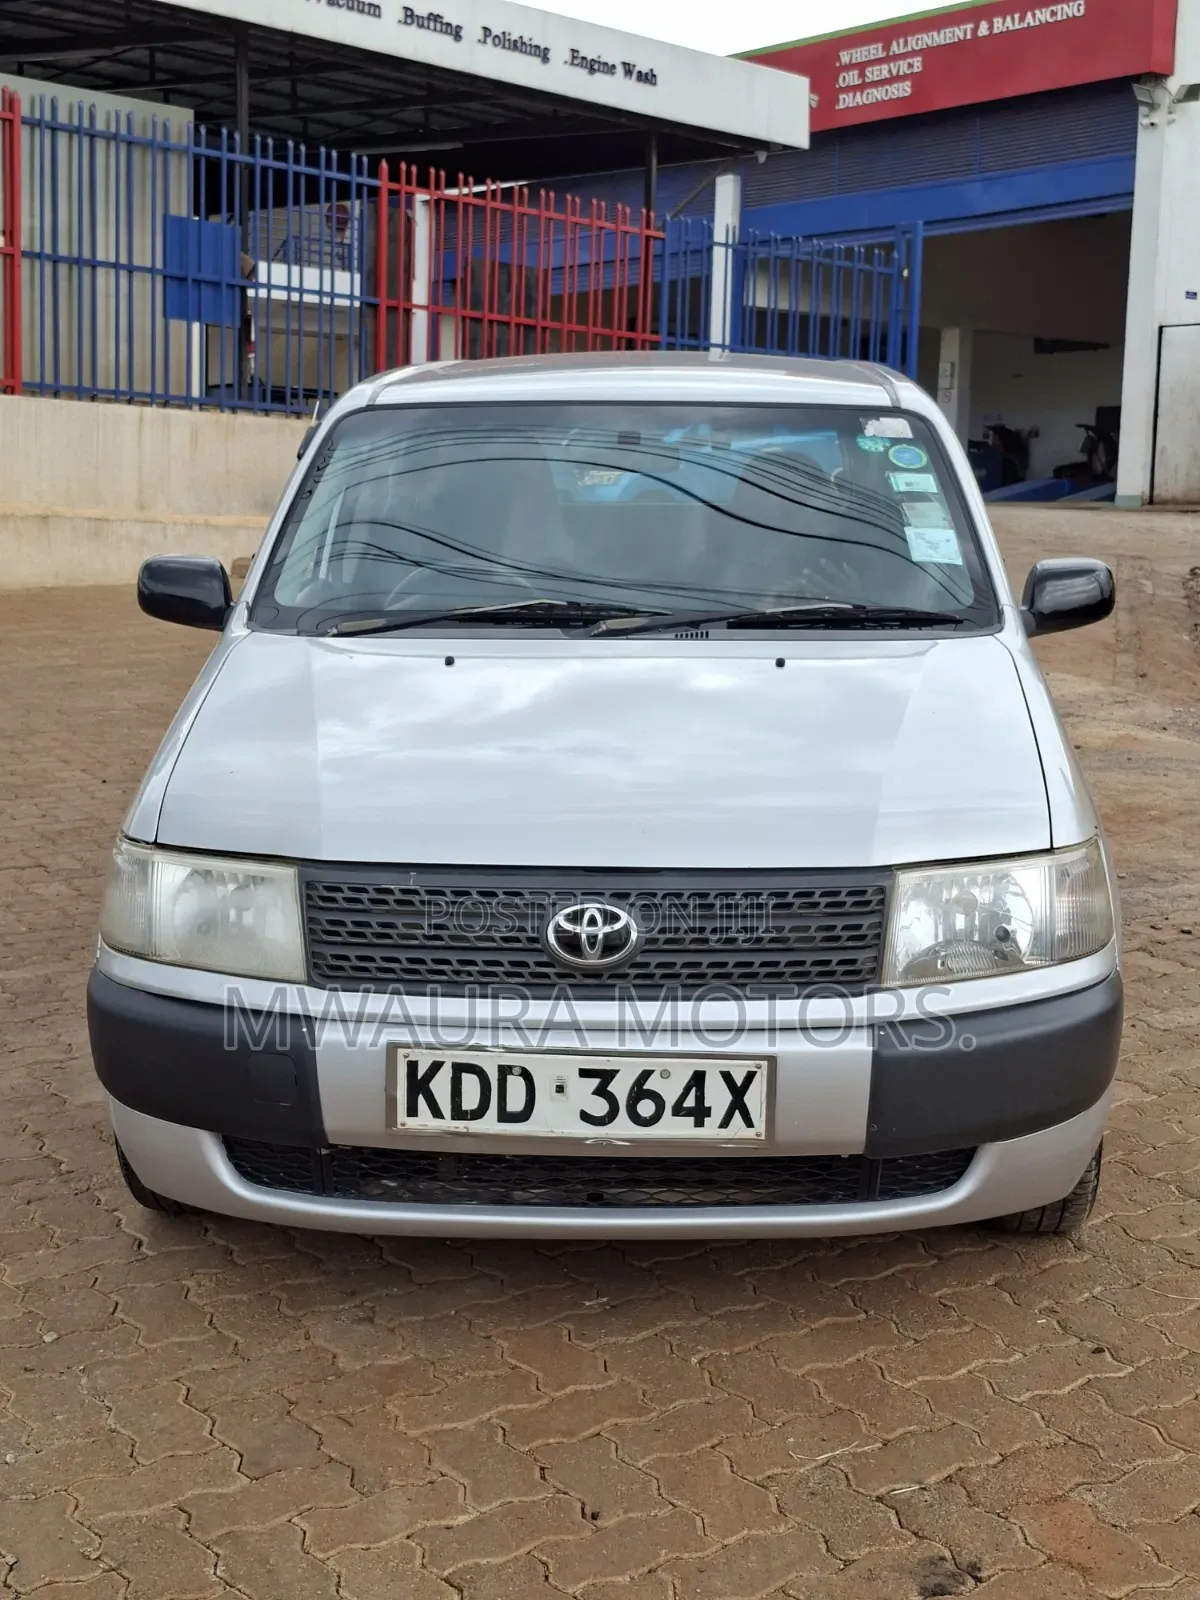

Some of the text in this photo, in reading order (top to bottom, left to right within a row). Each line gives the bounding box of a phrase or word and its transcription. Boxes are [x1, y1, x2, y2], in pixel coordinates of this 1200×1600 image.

[397, 6, 463, 42] .Buffing
[477, 26, 551, 64] .Polishing
[563, 48, 618, 76] .Engine
[621, 62, 658, 87] Wash
[836, 0, 1086, 67] .WHEEL ALIGNMENT & BALANCING
[835, 81, 912, 110] .DIAGNOSIS
[836, 57, 922, 89] .OIL SERVICE
[405, 1059, 759, 1130] KDD 364X
